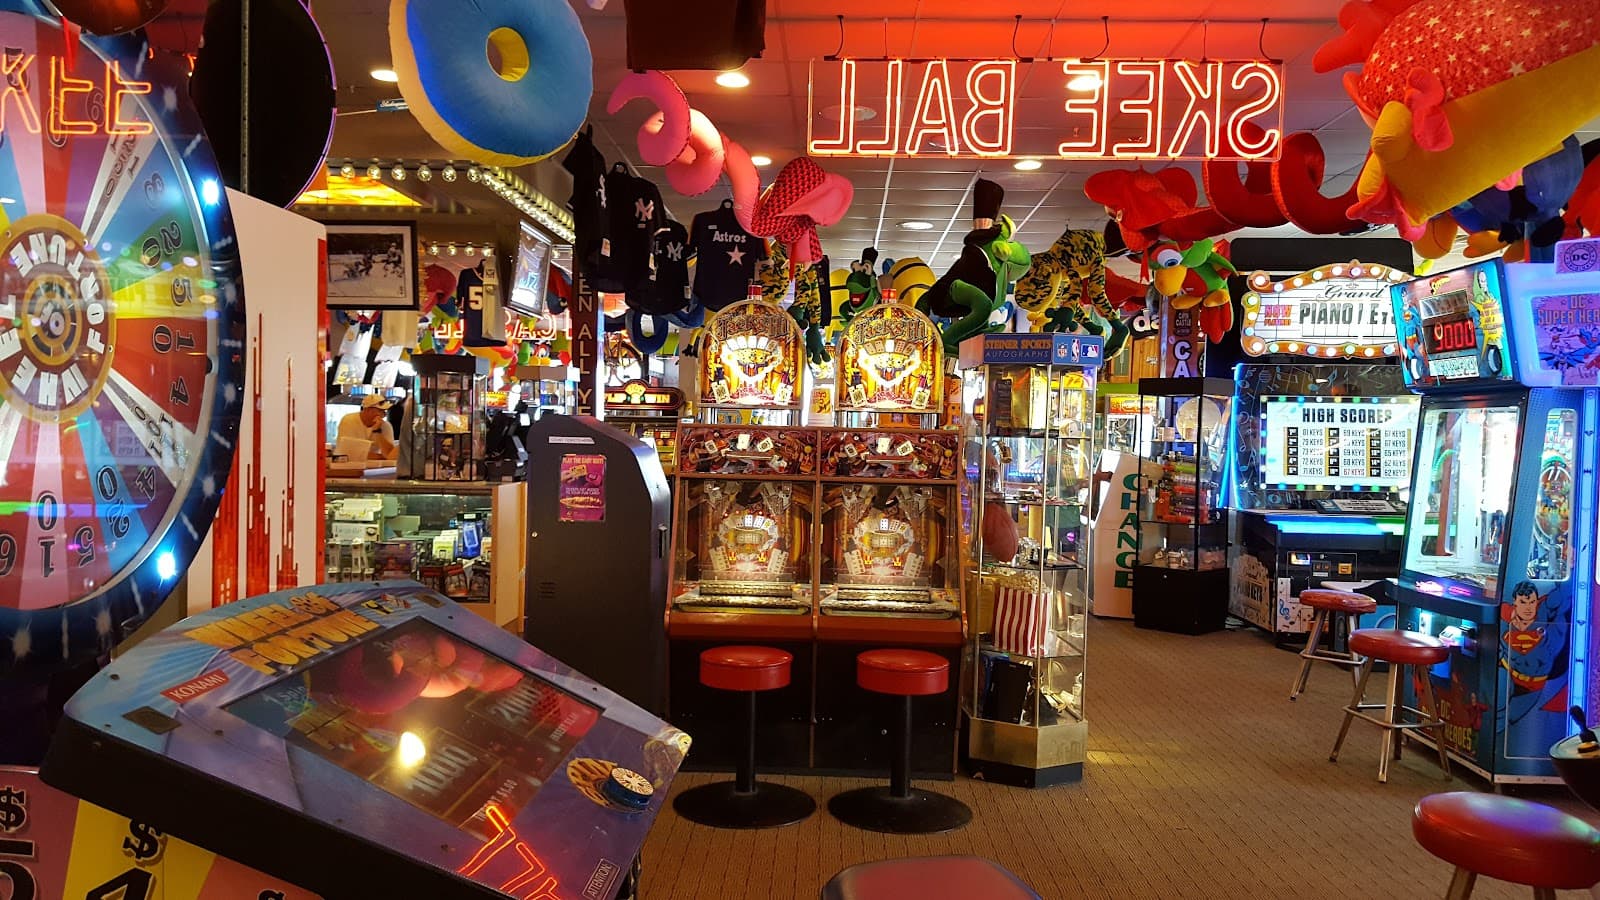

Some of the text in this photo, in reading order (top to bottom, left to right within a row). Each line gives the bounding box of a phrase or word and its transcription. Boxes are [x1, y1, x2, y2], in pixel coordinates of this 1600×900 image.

[712, 230, 747, 243] Astros
[1570, 295, 1587, 309] DC
[1299, 303, 1354, 325] PIANO
[1537, 309, 1576, 325] SUPER
[1021, 339, 1052, 349] SPORTS
[985, 350, 1049, 359] AUTOGRAPHS
[1302, 408, 1393, 424] HIGH SCORES
[1114, 473, 1143, 588] CHANGE
[182, 604, 315, 649] WHEEL
[229, 609, 380, 675] FORTUNE
[168, 674, 227, 700] KONAMI
